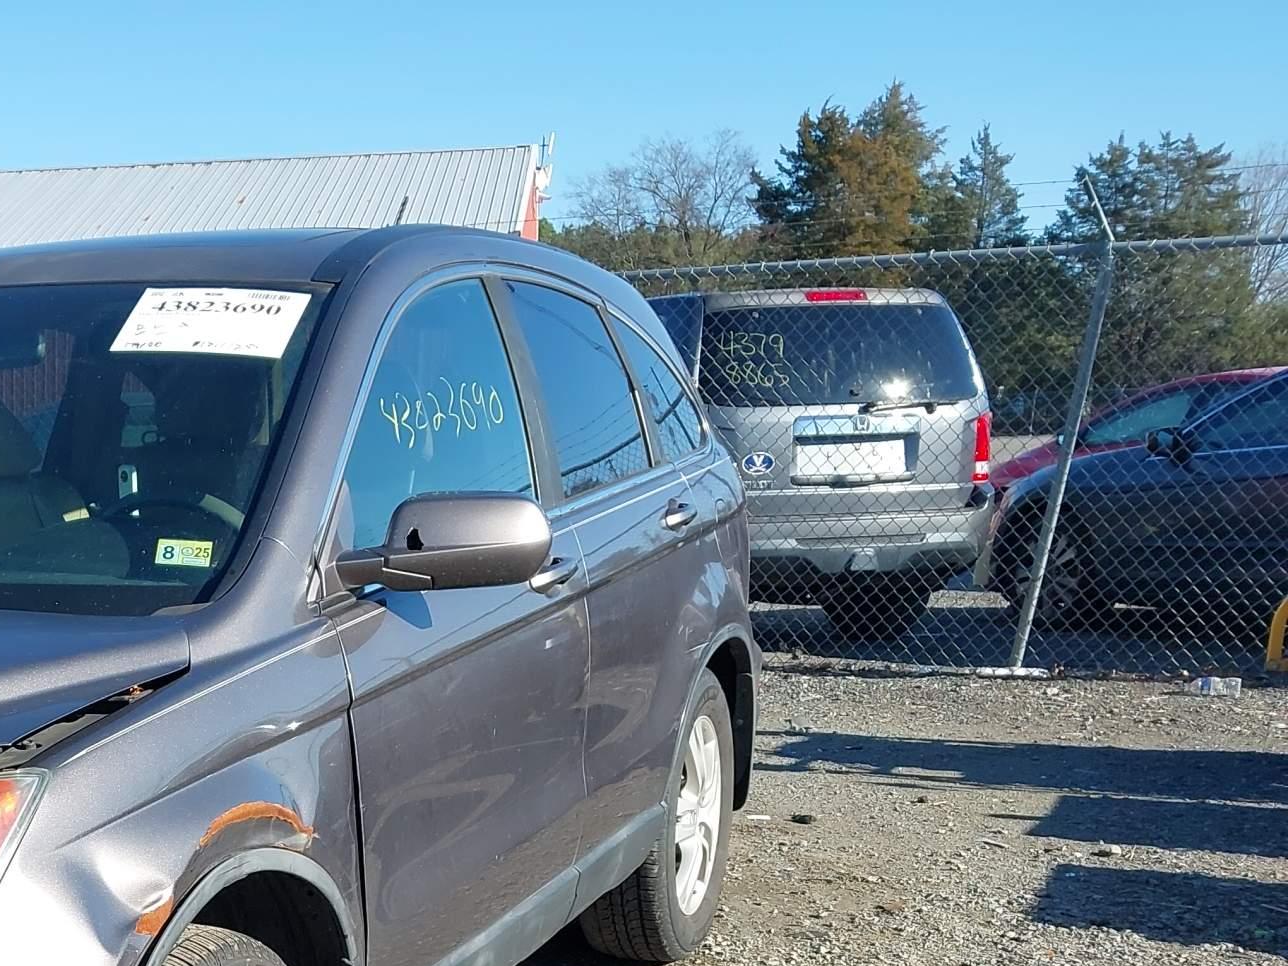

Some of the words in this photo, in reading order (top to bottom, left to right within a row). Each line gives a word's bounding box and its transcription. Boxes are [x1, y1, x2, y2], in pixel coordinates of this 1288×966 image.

[151, 300, 282, 316] 43823690
[719, 331, 784, 357] 4379
[162, 545, 175, 560] 8
[194, 547, 210, 559] 25
